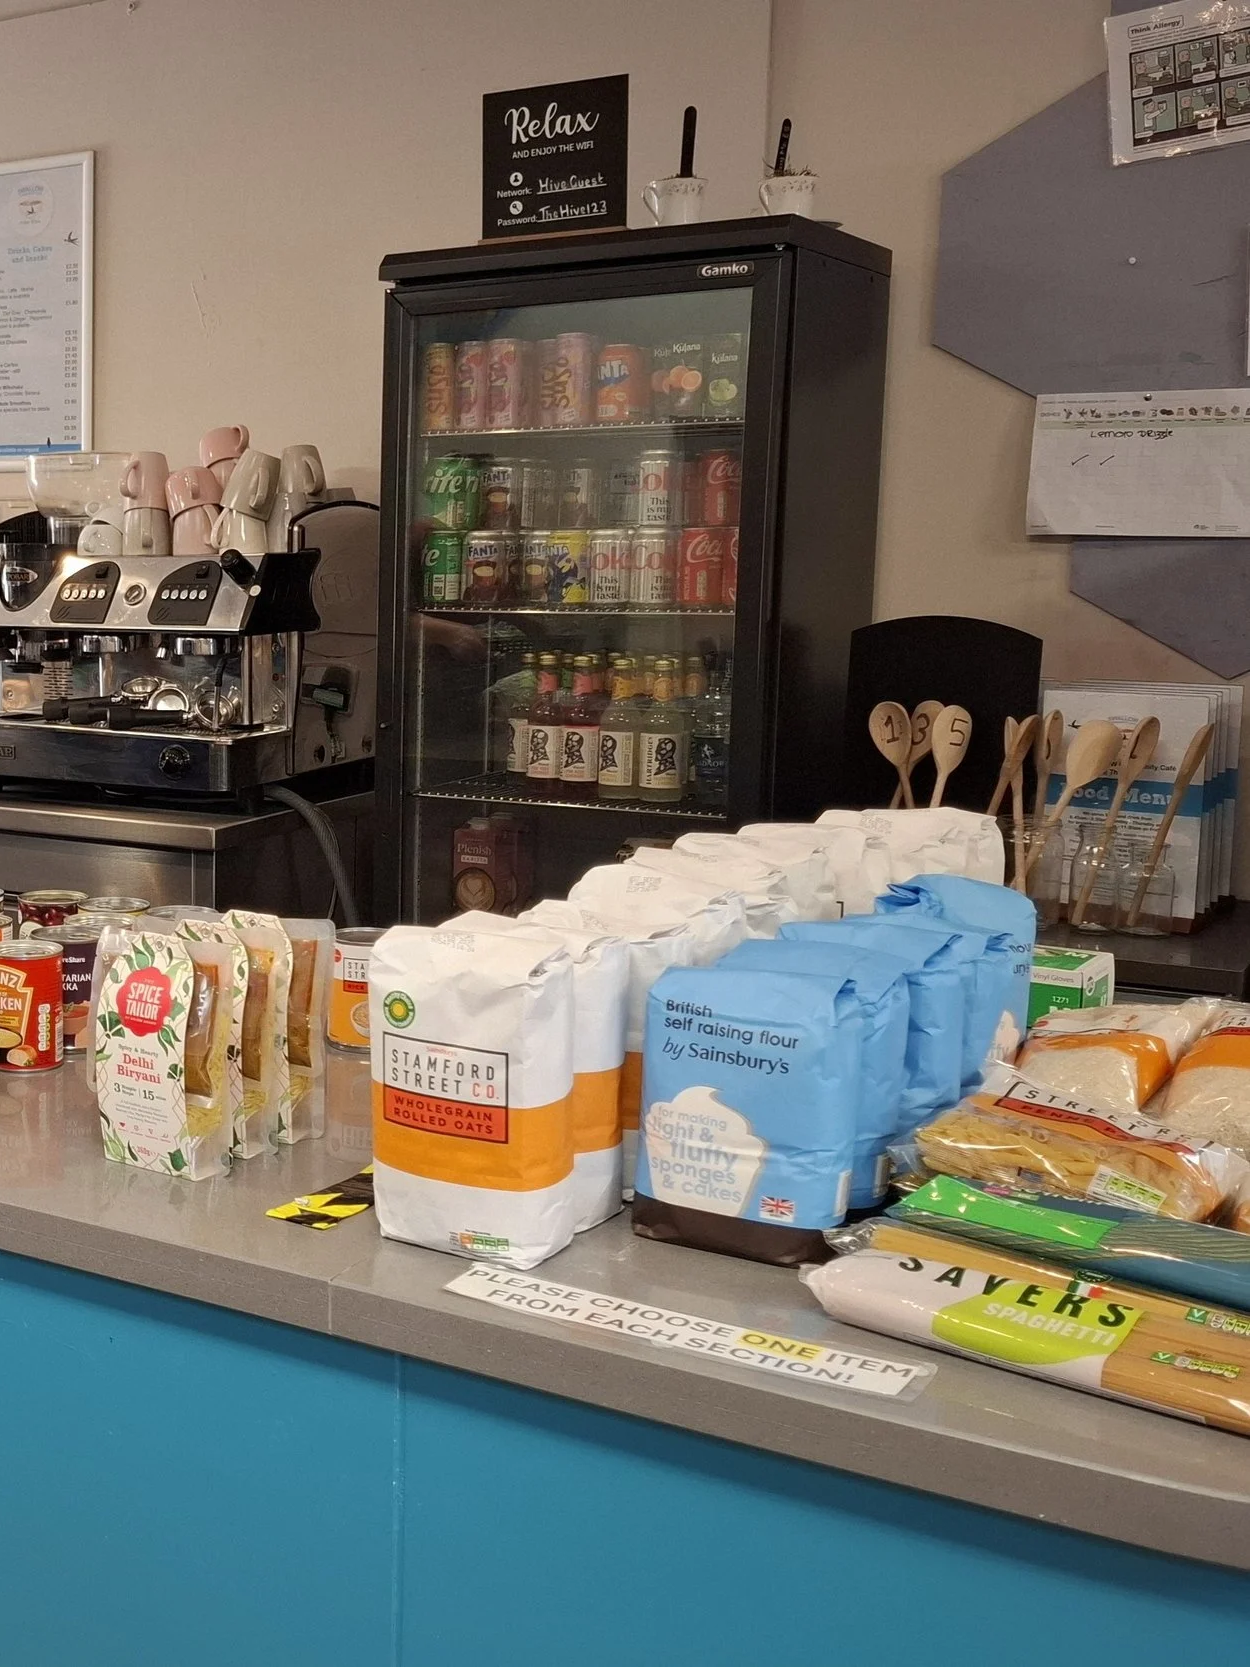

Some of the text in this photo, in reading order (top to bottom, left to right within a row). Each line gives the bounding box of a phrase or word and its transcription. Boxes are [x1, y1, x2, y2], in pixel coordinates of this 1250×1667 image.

[504, 102, 600, 145] Relax
[512, 140, 594, 160] AND ENJOY THE WIFI
[496, 187, 532, 200] Network:
[497, 214, 537, 227] Password:
[701, 263, 748, 277] Gamko
[598, 359, 629, 380] NTA
[883, 715, 899, 744] 1
[911, 713, 928, 745] 3
[949, 718, 969, 746] 5
[457, 843, 492, 855] Plenish
[1033, 973, 1075, 983] Vinyl Gloves
[129, 982, 164, 1004] SPICE
[1052, 996, 1070, 1004] 1271
[126, 999, 160, 1021] TAILOR
[665, 999, 713, 1018] British
[664, 1016, 799, 1050] self raising flour
[123, 1053, 154, 1070] Delhi
[392, 1049, 495, 1081] STAMFORD
[662, 1037, 790, 1075] by Sainsbury's
[117, 1064, 161, 1084] Biryani
[392, 1067, 500, 1099] STREET CO.
[114, 1083, 121, 1093] 3
[143, 1089, 155, 1100] 15
[394, 1095, 493, 1122] WHOLEGRAIN
[394, 1107, 493, 1134] ROLLED OATS
[658, 1106, 727, 1132] for making
[1025, 1089, 1142, 1131] STREET
[652, 1116, 714, 1143] light &
[670, 1138, 739, 1173] fluffy
[651, 1154, 736, 1185] sponges
[662, 1174, 743, 1203] & cakes
[898, 1256, 1139, 1329] SAVERS
[468, 1269, 920, 1379] PLEASE CHOOSE ONE ITEM
[486, 1289, 855, 1384] FROM EACH SECTION!
[982, 1303, 1117, 1347] SPAGHETTI
